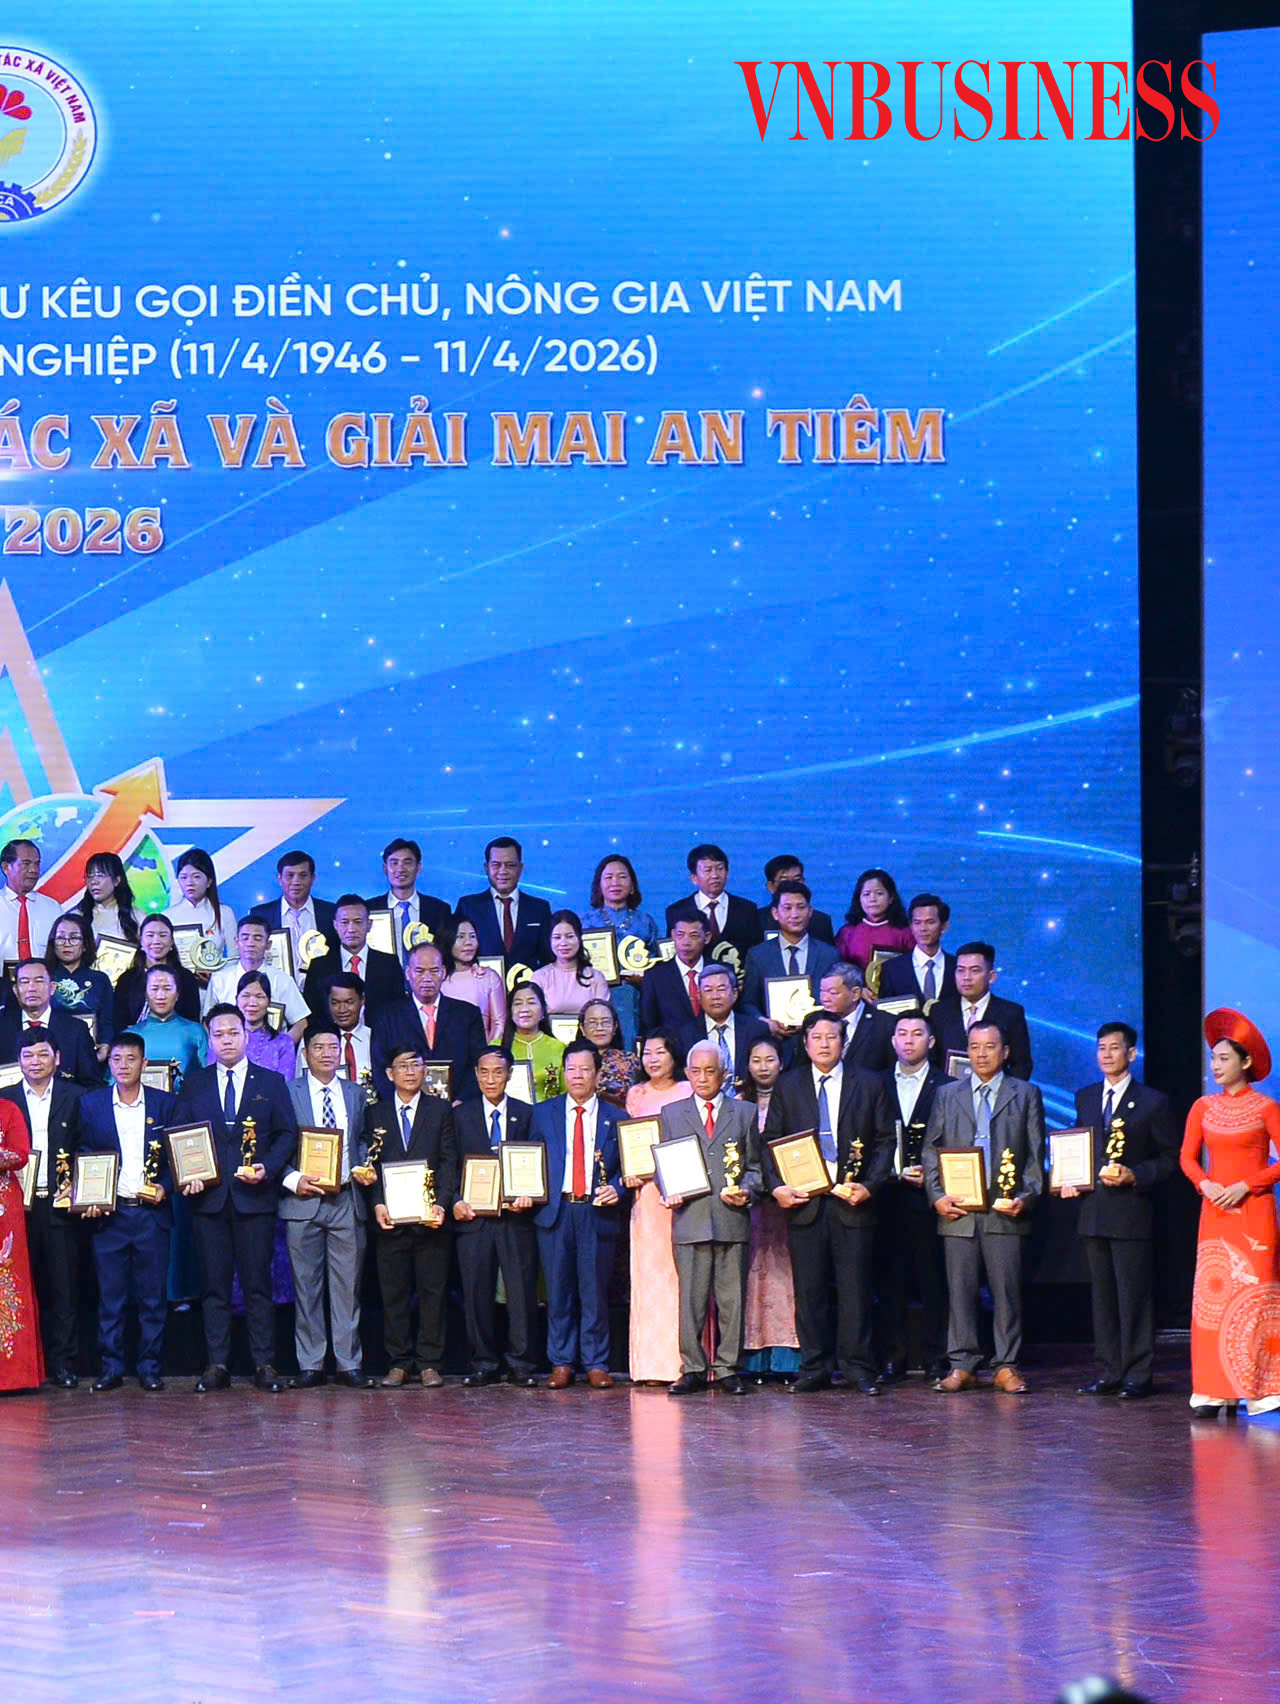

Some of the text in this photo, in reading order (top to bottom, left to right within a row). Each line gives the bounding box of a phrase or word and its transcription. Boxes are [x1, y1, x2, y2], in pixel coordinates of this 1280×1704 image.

[65, 94, 86, 123] NAM
[42, 277, 123, 319] KÊU
[135, 284, 218, 327] GỌI
[232, 273, 333, 317] ĐIỀN
[345, 272, 452, 321] CHỦ,
[465, 273, 600, 315] NÔNG
[612, 281, 690, 314] GIA
[702, 273, 794, 322] VIỆT
[806, 279, 903, 312] NAM
[170, 337, 388, 379] (11/4/1946
[433, 335, 658, 376] 11/4/2026)
[90, 399, 193, 469] XÃ
[206, 396, 306, 468] VÀ
[325, 395, 469, 468] GIẢI
[490, 410, 627, 466] MAI
[646, 409, 745, 465] AN
[766, 394, 946, 464] TIÊM
[3, 506, 164, 555] 2026
